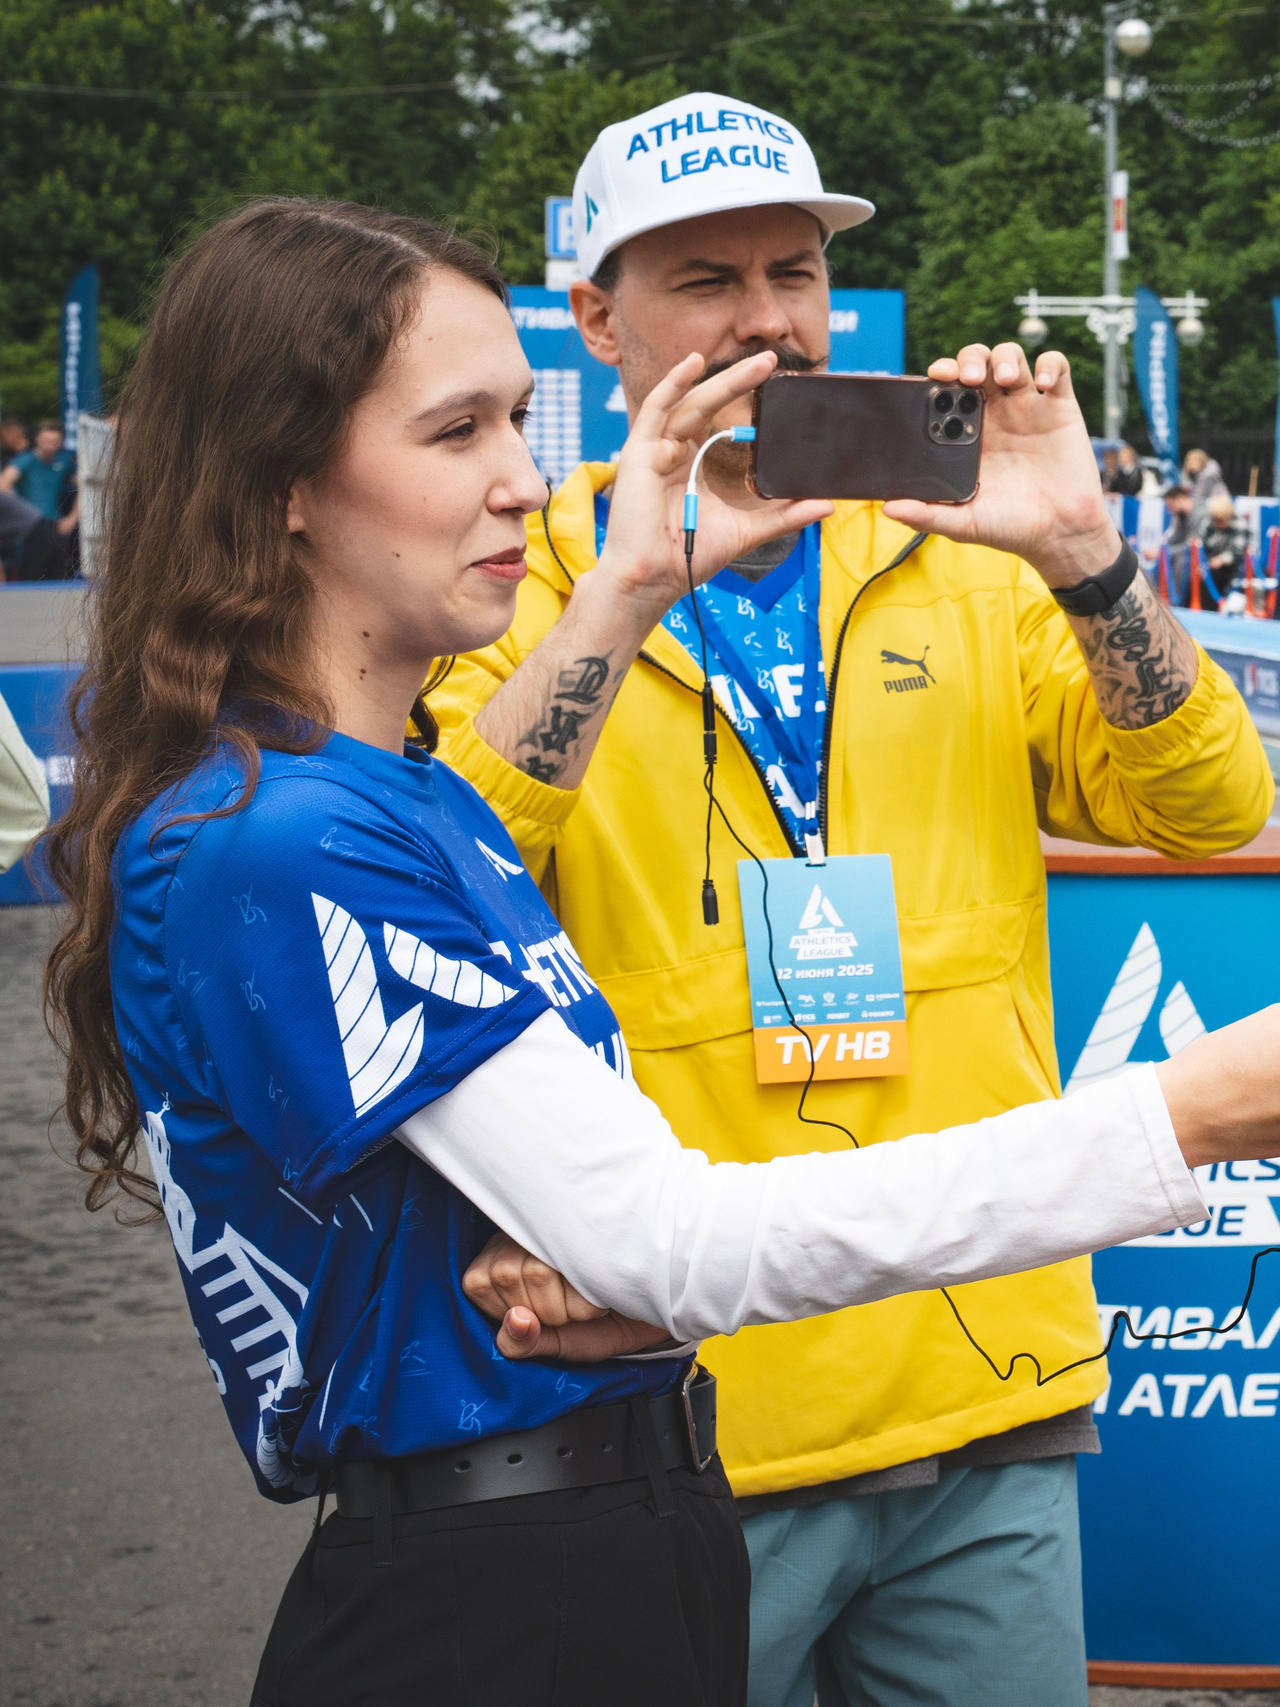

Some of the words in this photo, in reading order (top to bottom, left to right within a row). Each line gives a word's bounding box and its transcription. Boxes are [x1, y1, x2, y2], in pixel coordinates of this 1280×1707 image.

[627, 110, 794, 161] ATHLETICS
[661, 145, 790, 184] LEAGUE
[883, 675, 928, 693] PUMA
[793, 935, 852, 946] ATHLETICS
[803, 948, 845, 957] LEAGUE
[777, 968, 792, 980] 12
[837, 963, 874, 977] 2025
[776, 1034, 830, 1064] TV
[835, 1030, 890, 1061] HB
